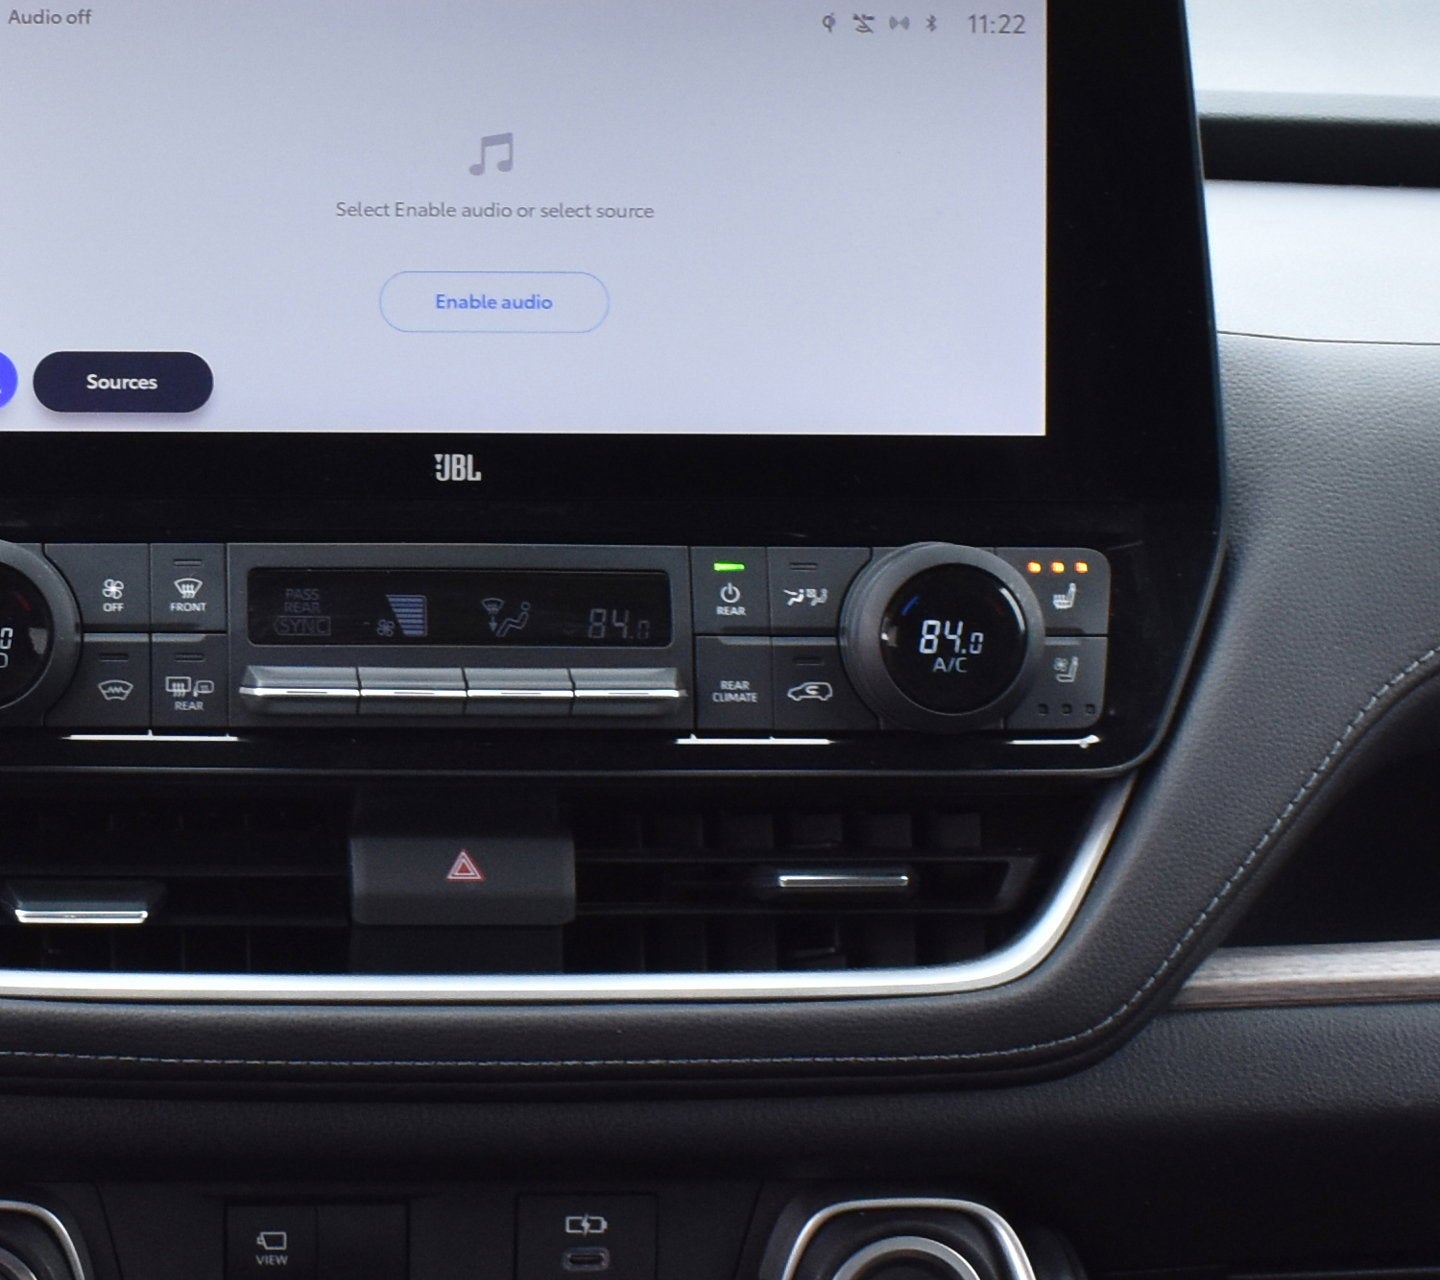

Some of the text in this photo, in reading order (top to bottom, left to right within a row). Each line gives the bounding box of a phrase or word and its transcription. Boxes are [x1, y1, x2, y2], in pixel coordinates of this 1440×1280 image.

[8, 8, 92, 25] Audio off
[968, 14, 1026, 34] 11:22
[335, 201, 655, 219] Select Enable audio or select source
[435, 293, 553, 310] Enable audio
[86, 373, 158, 390] Sources
[434, 453, 482, 481] JBL
[285, 588, 320, 600] PASS
[102, 602, 125, 613] OFF
[170, 602, 207, 613] FRONT
[716, 605, 746, 617] REAR
[919, 620, 984, 656] 84.0
[932, 657, 968, 674] A/C
[720, 680, 750, 691] REAR
[712, 691, 758, 703] CLIMATE
[174, 700, 204, 711] REAR
[255, 1254, 288, 1266] VIEW
